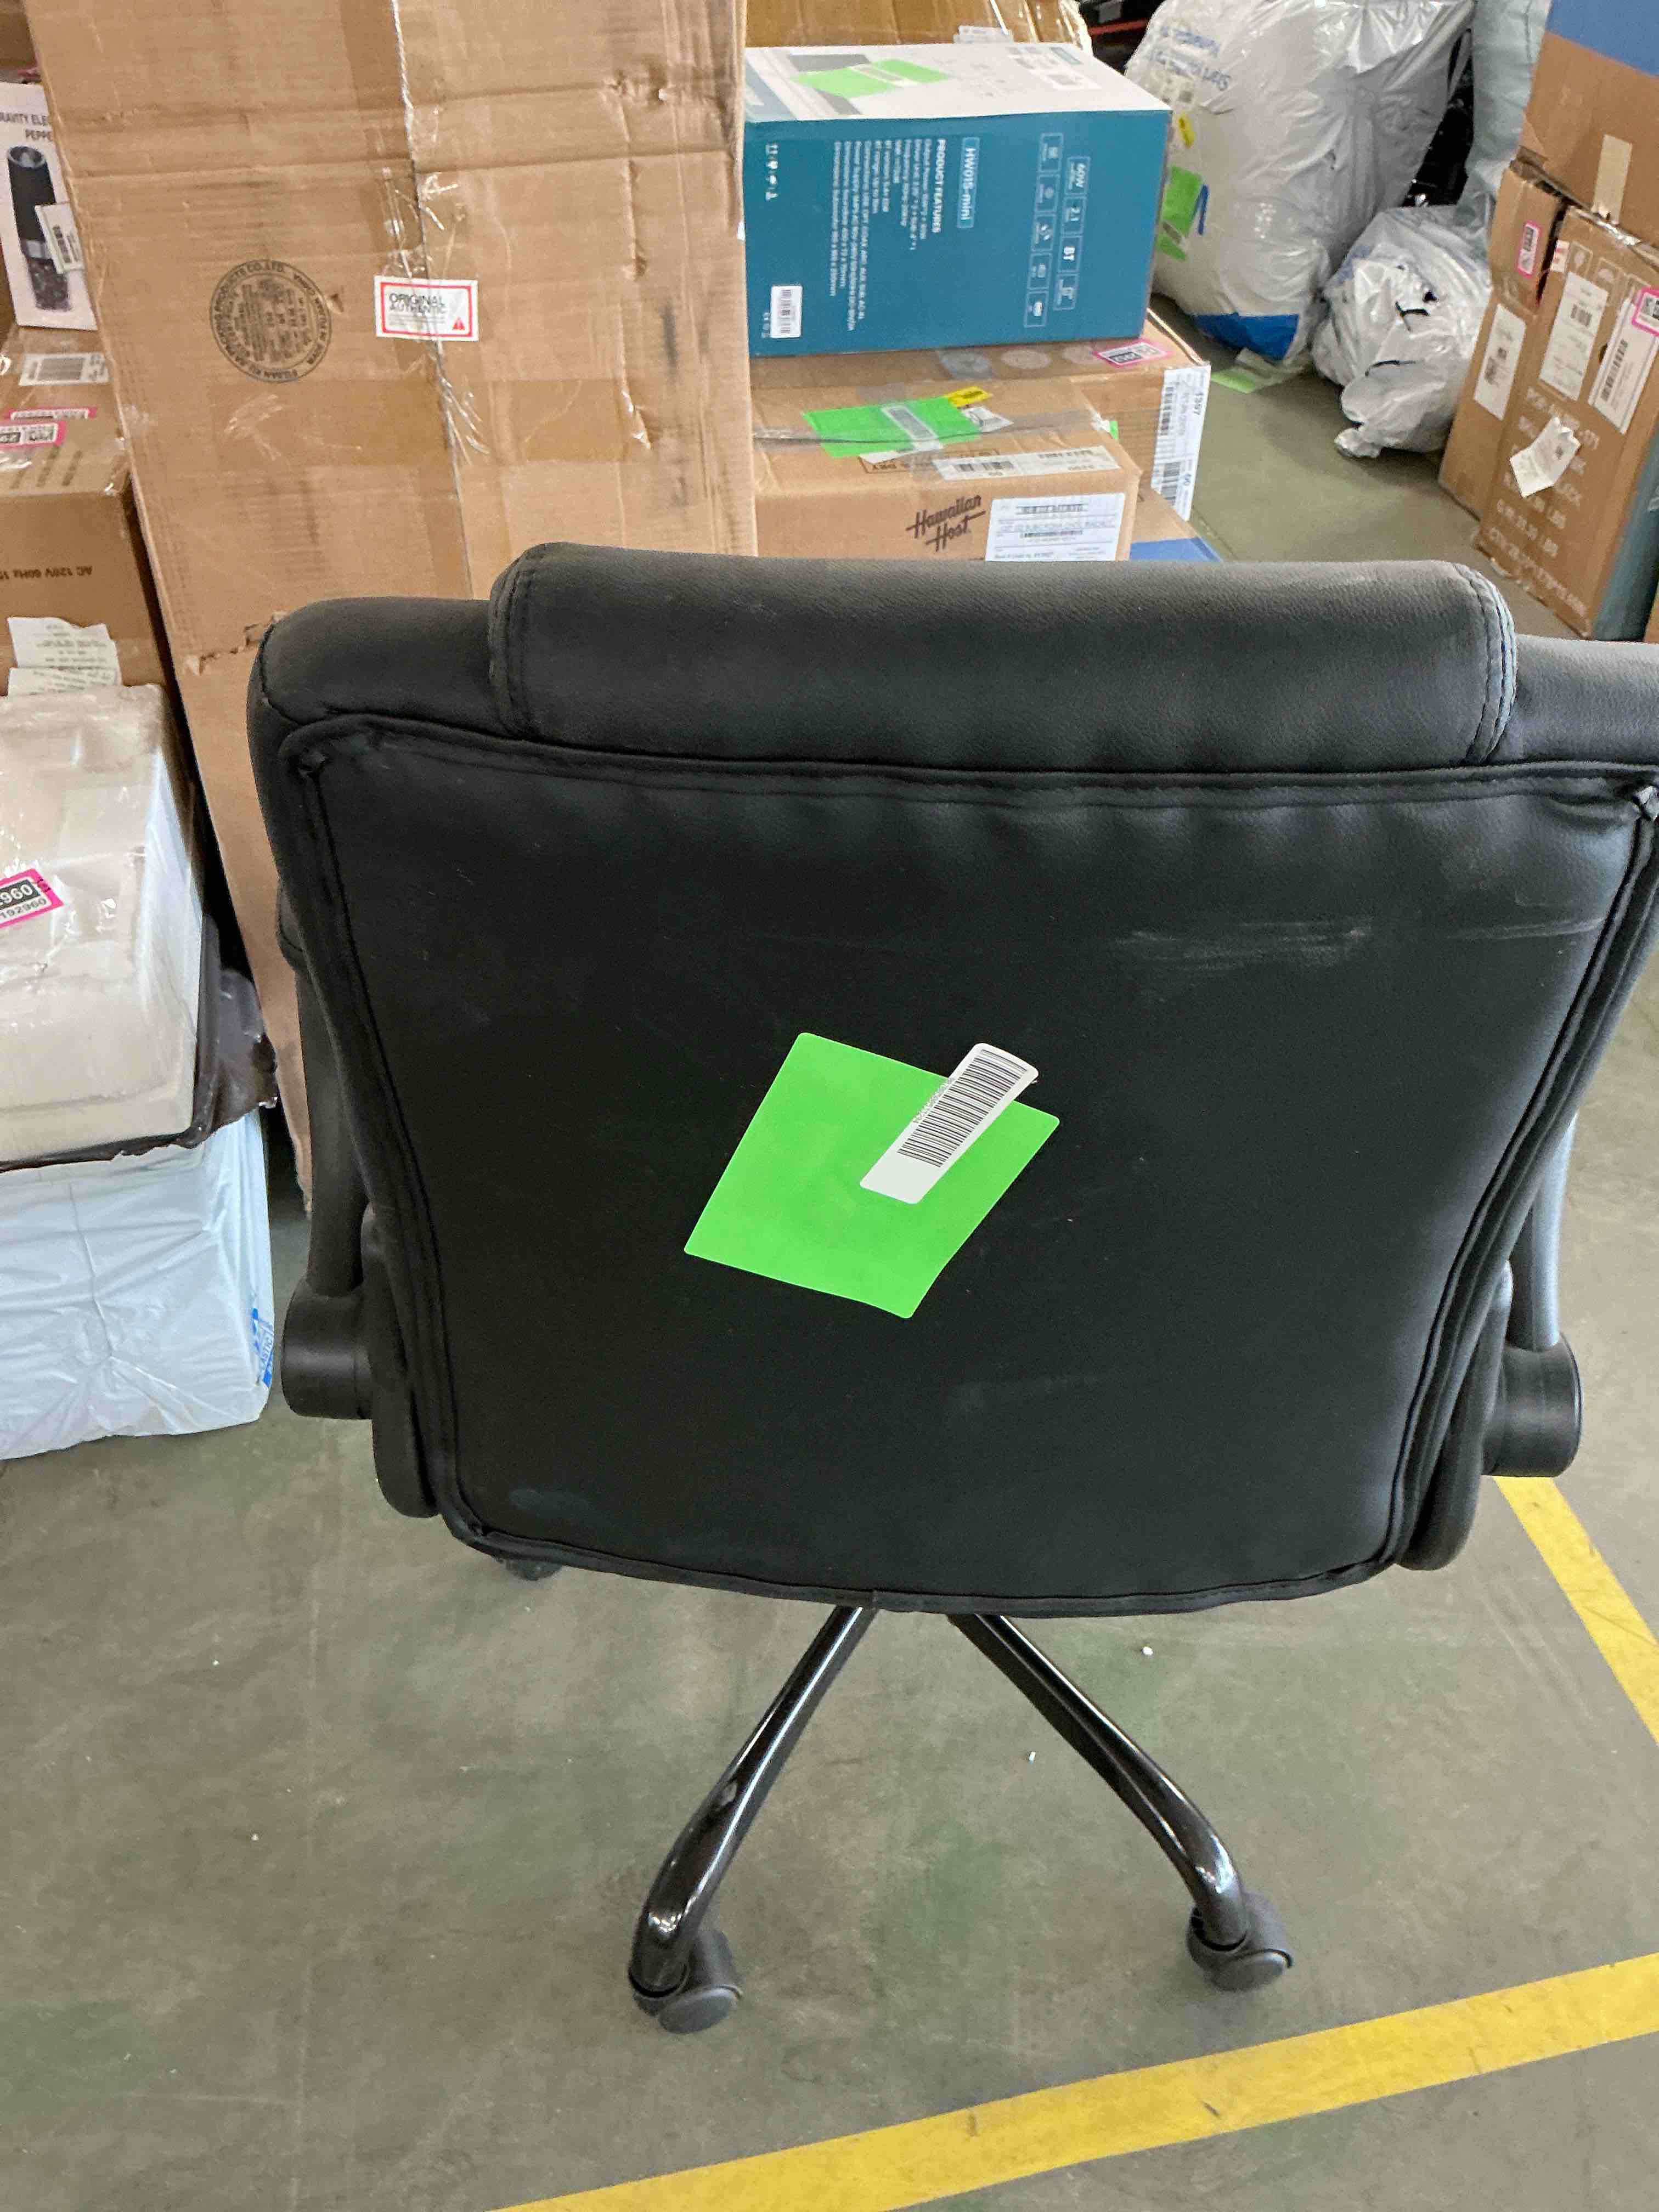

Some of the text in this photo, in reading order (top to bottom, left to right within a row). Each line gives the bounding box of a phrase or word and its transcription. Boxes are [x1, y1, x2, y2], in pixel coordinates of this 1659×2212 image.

[932, 139, 946, 233] PRODUCT FEATURES
[1070, 207, 1080, 222] 2.1
[1063, 246, 1076, 261] BT
[906, 495, 981, 539] Hawaiian
[925, 510, 986, 552] Host
[77, 566, 93, 576] AC
[0, 884, 33, 907] 960
